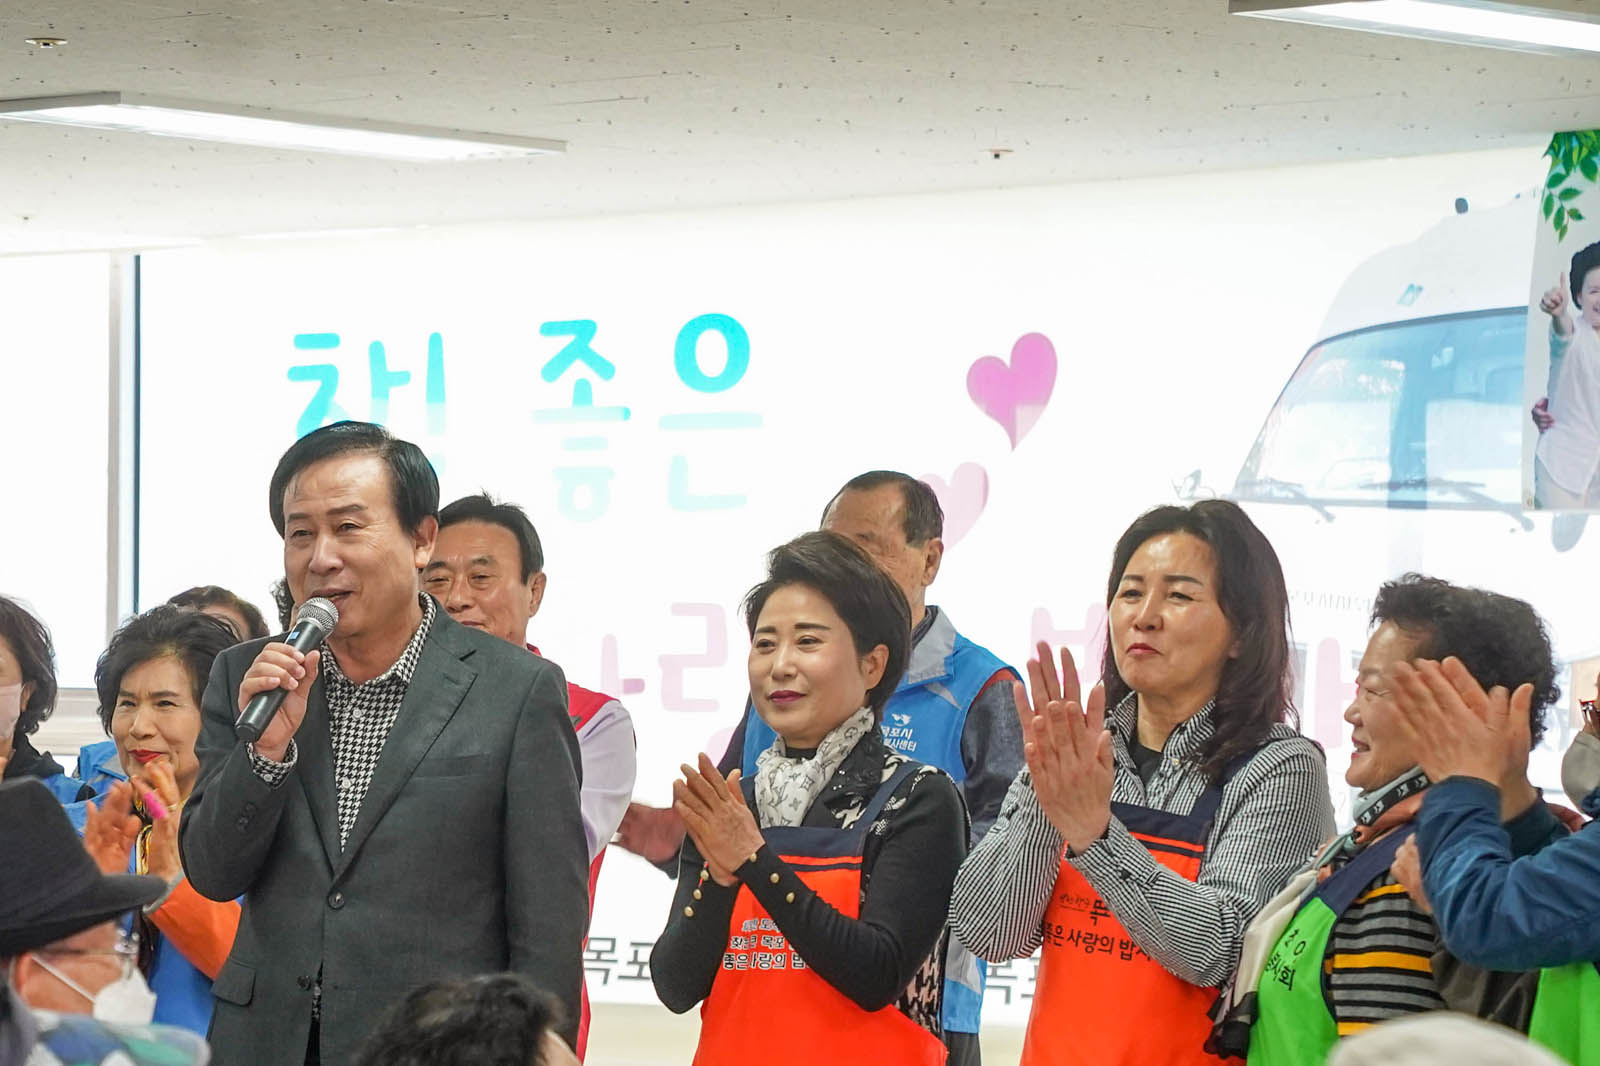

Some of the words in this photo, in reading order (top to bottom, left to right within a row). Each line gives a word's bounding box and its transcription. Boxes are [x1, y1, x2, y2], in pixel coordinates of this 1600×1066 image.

[529, 311, 765, 523] 좋은
[761, 935, 786, 950] 목포
[1067, 928, 1115, 955] 사랑의
[723, 952, 749, 970] 좋은
